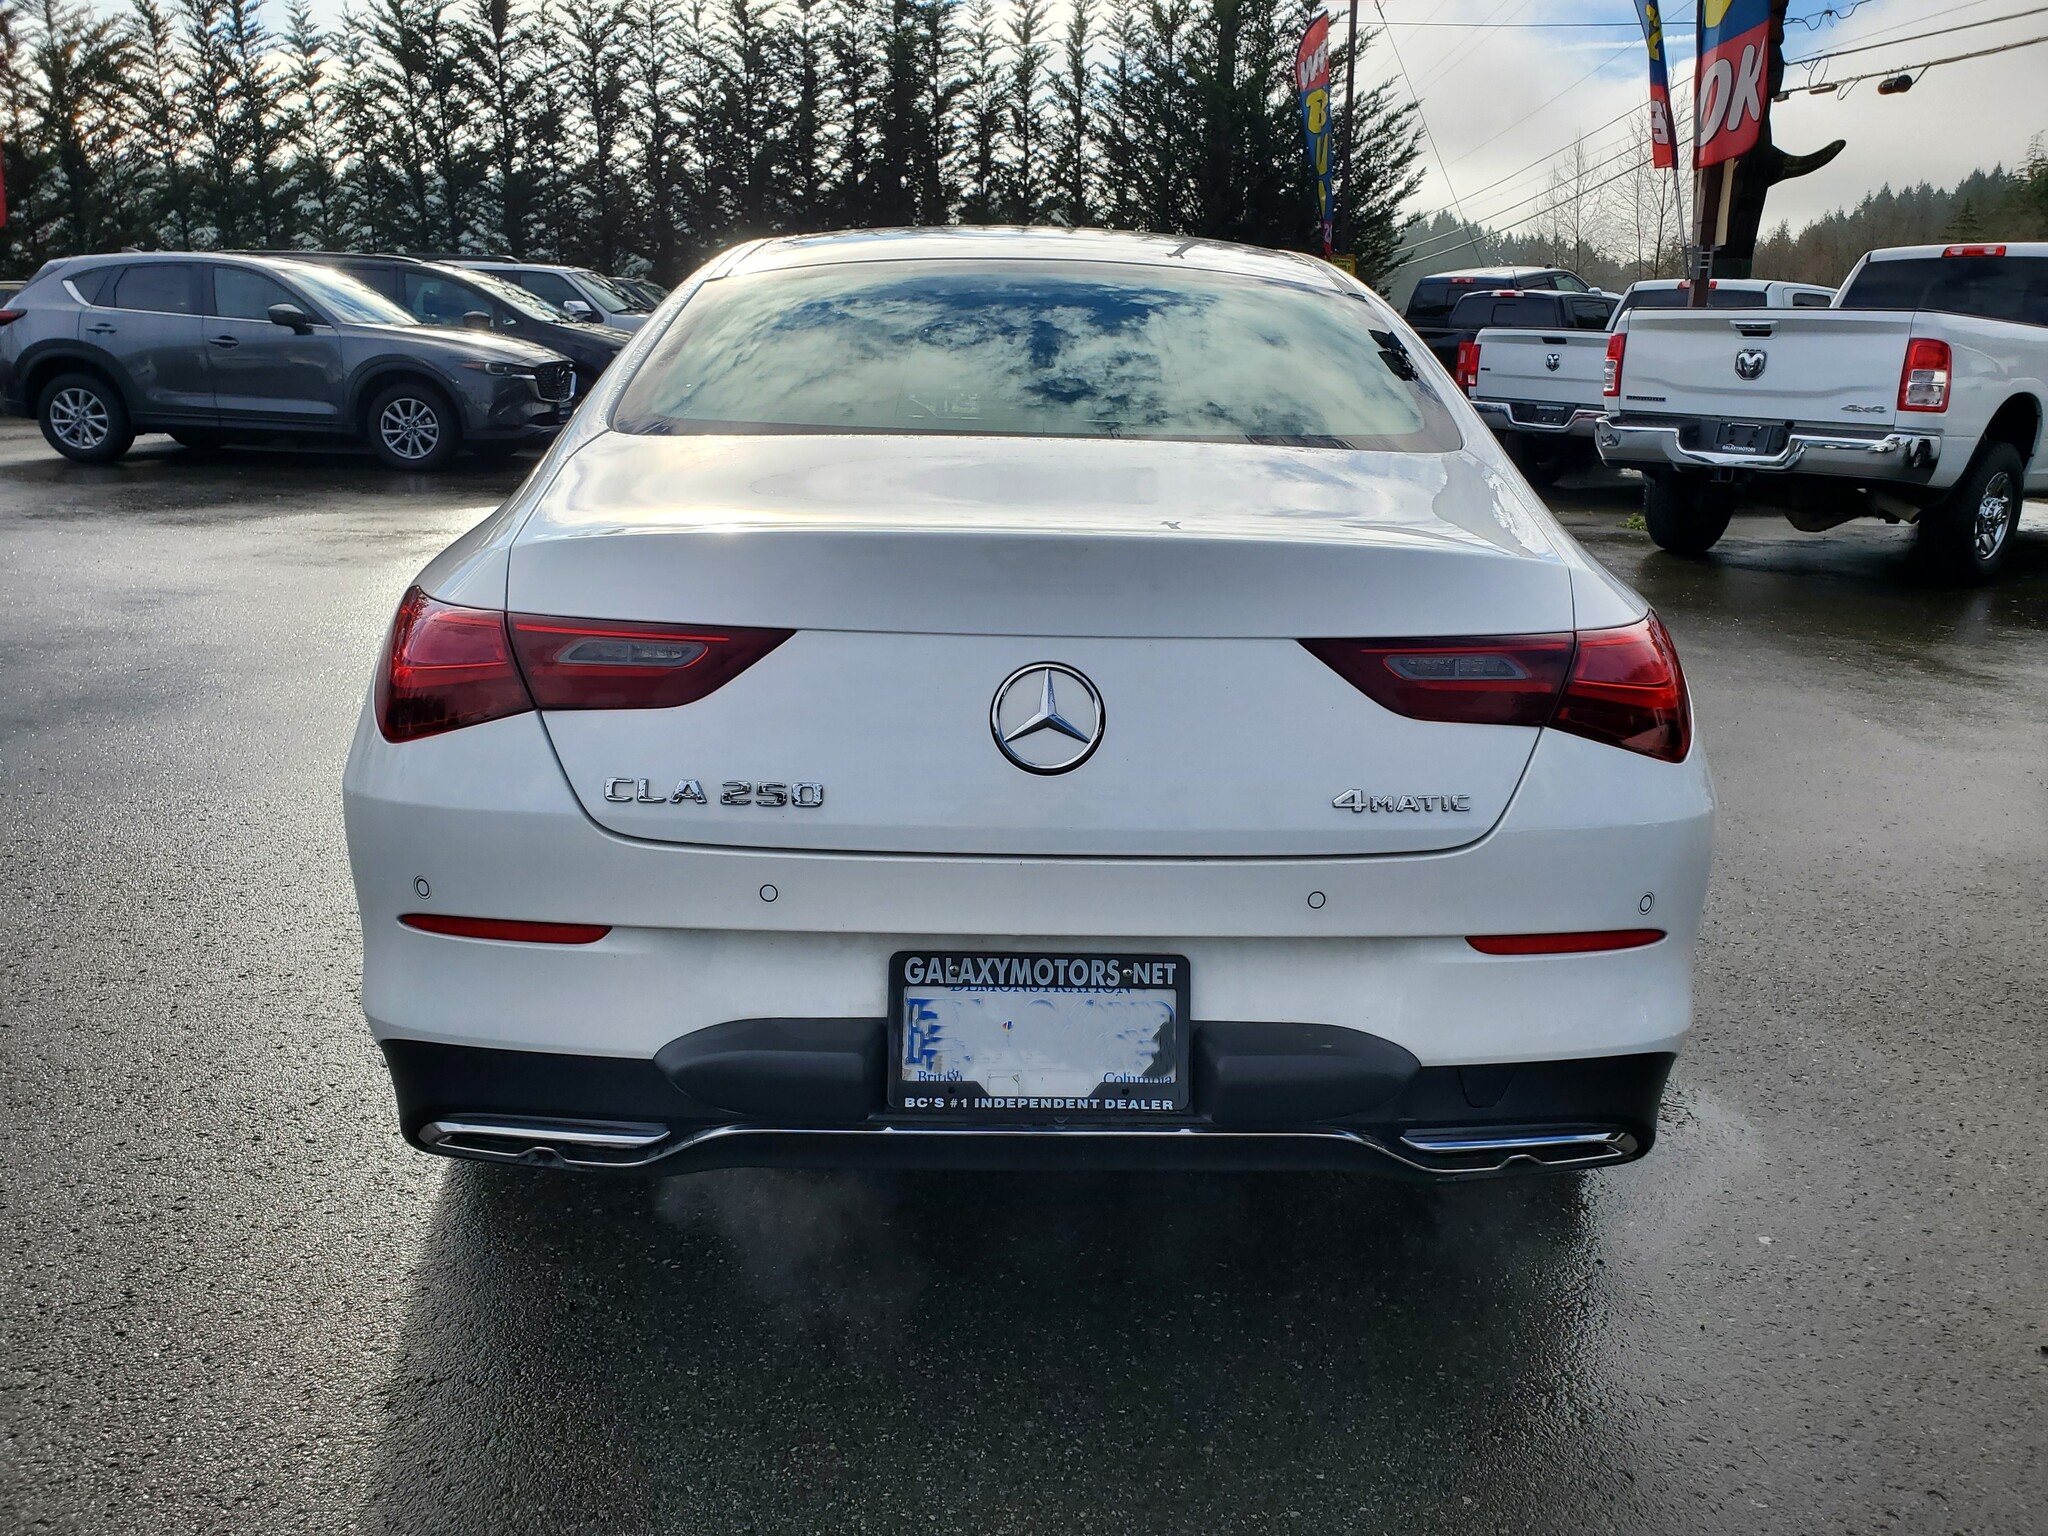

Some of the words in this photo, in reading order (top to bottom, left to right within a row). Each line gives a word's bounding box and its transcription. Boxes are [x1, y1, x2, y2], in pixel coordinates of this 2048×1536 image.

[604, 777, 707, 804] CLA
[720, 780, 824, 808] 250
[1332, 788, 1471, 812] 4MATIC
[904, 1097, 945, 1108] BC'S
[949, 1098, 968, 1108] #1
[974, 1098, 1100, 1109] INDEPENDENT
[1104, 1099, 1174, 1110] DEALER
